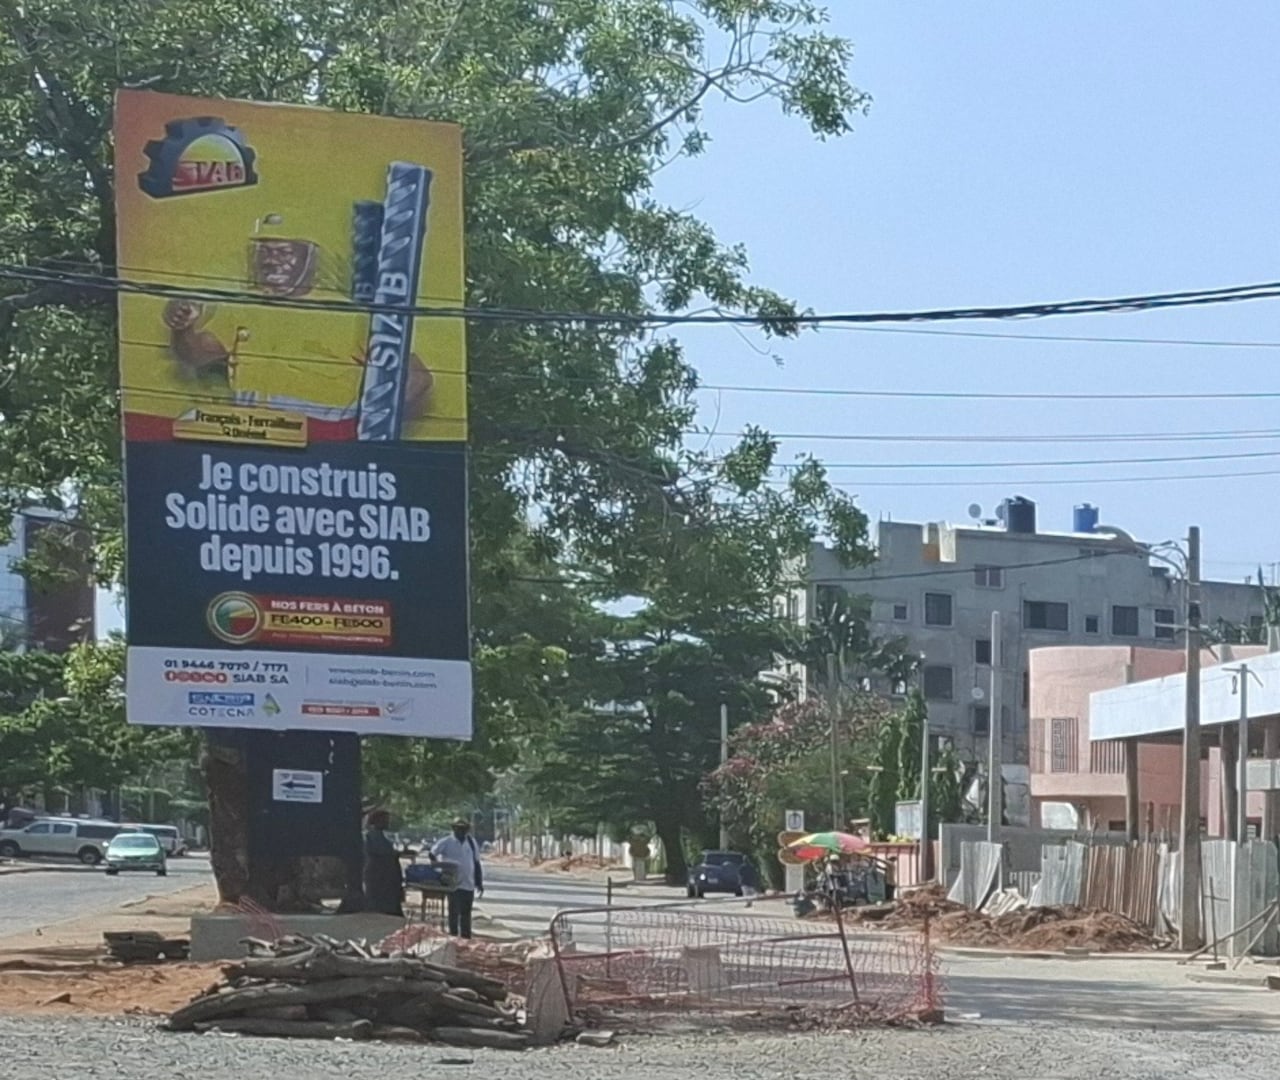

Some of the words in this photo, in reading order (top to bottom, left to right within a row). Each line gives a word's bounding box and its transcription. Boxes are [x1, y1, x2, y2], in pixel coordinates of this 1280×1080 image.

[199, 454, 233, 491] Je
[239, 462, 397, 501] construis
[165, 493, 270, 533] Solide
[275, 505, 354, 538] avec
[359, 504, 431, 542] SIAB
[200, 534, 313, 580] depuis
[319, 542, 400, 580] 1996.
[271, 600, 297, 610] NOS
[300, 601, 329, 612] FERS
[164, 660, 178, 668] 01
[232, 674, 266, 684] SIAB
[269, 675, 289, 685] SA
